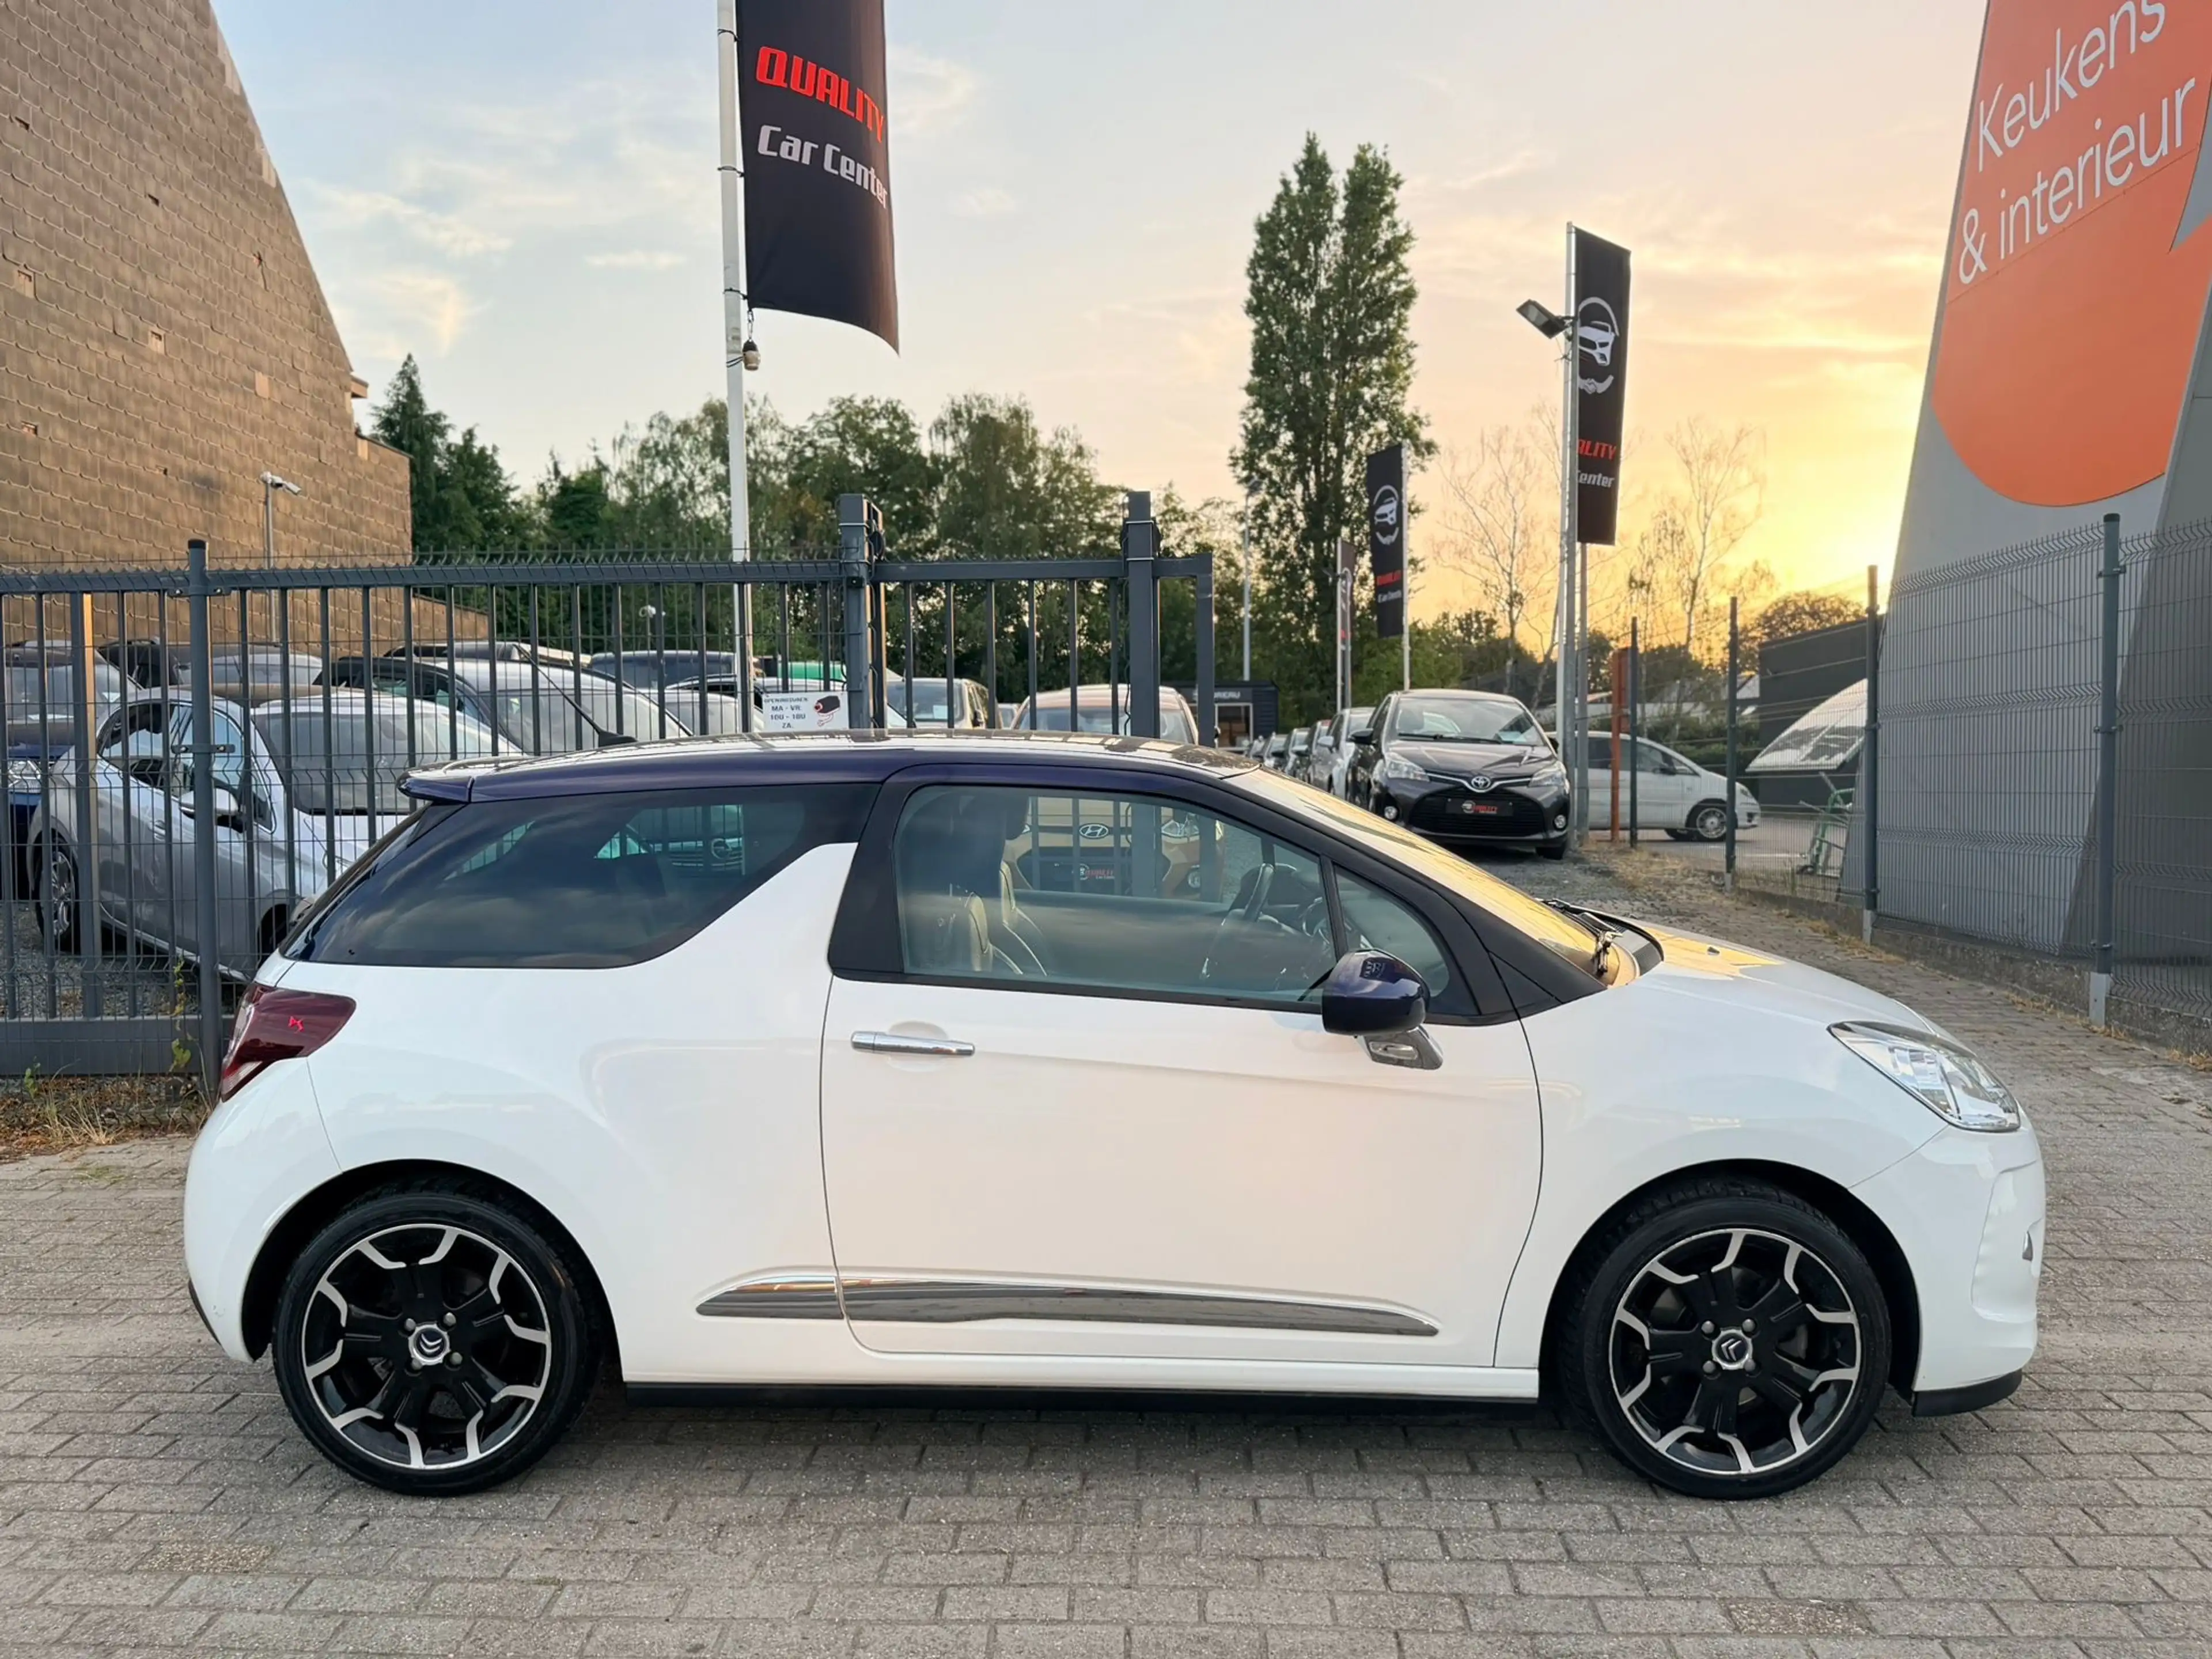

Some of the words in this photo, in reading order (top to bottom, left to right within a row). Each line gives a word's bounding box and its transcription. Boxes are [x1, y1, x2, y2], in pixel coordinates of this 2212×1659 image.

[755, 46, 884, 143] QUALITY
[1978, 0, 2165, 173] Keukens
[757, 124, 819, 166] Car
[824, 143, 888, 209] Center
[1959, 208, 1988, 285] &
[2000, 77, 2196, 260] interieur
[1577, 469, 1615, 488] enter
